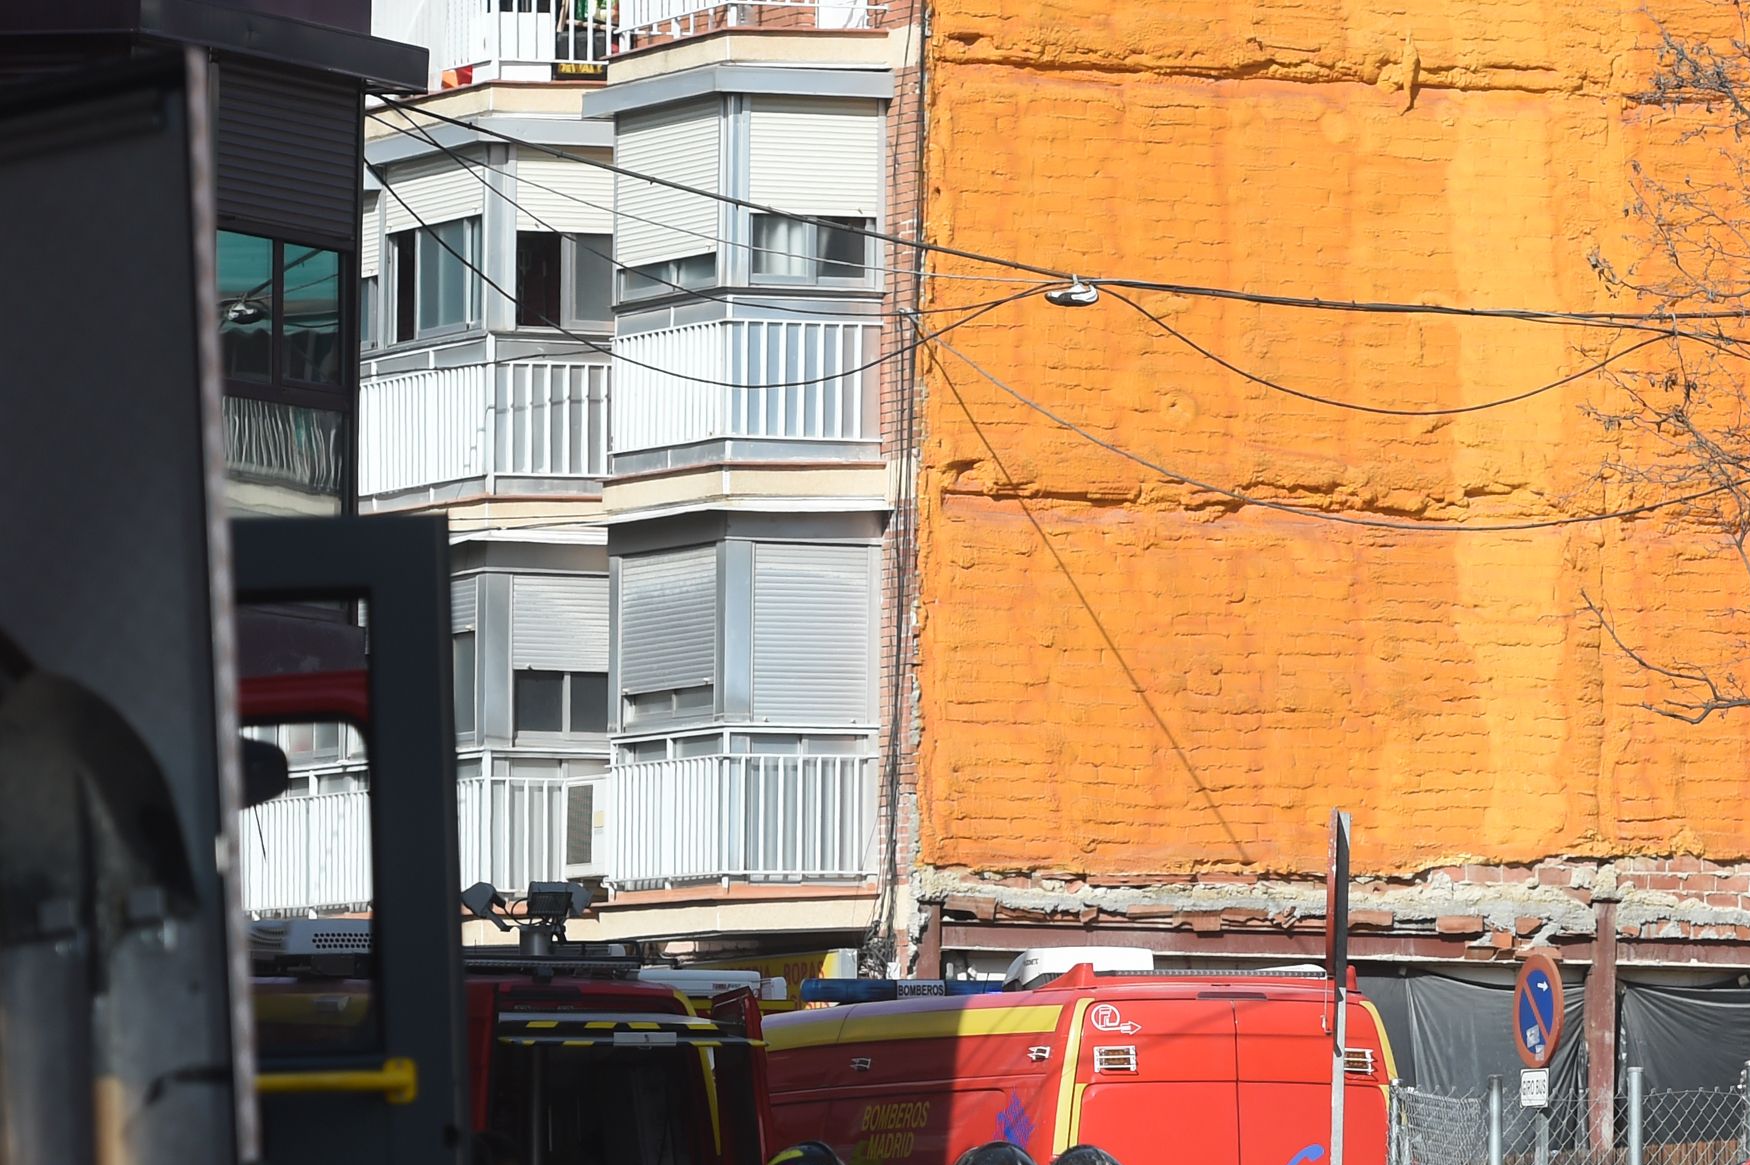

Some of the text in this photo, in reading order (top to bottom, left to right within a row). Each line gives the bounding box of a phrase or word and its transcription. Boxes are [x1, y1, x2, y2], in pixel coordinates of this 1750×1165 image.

[898, 984, 944, 997] BOMBEROS
[862, 1101, 930, 1131] BOMBEROS
[866, 1131, 915, 1160] MADRID
